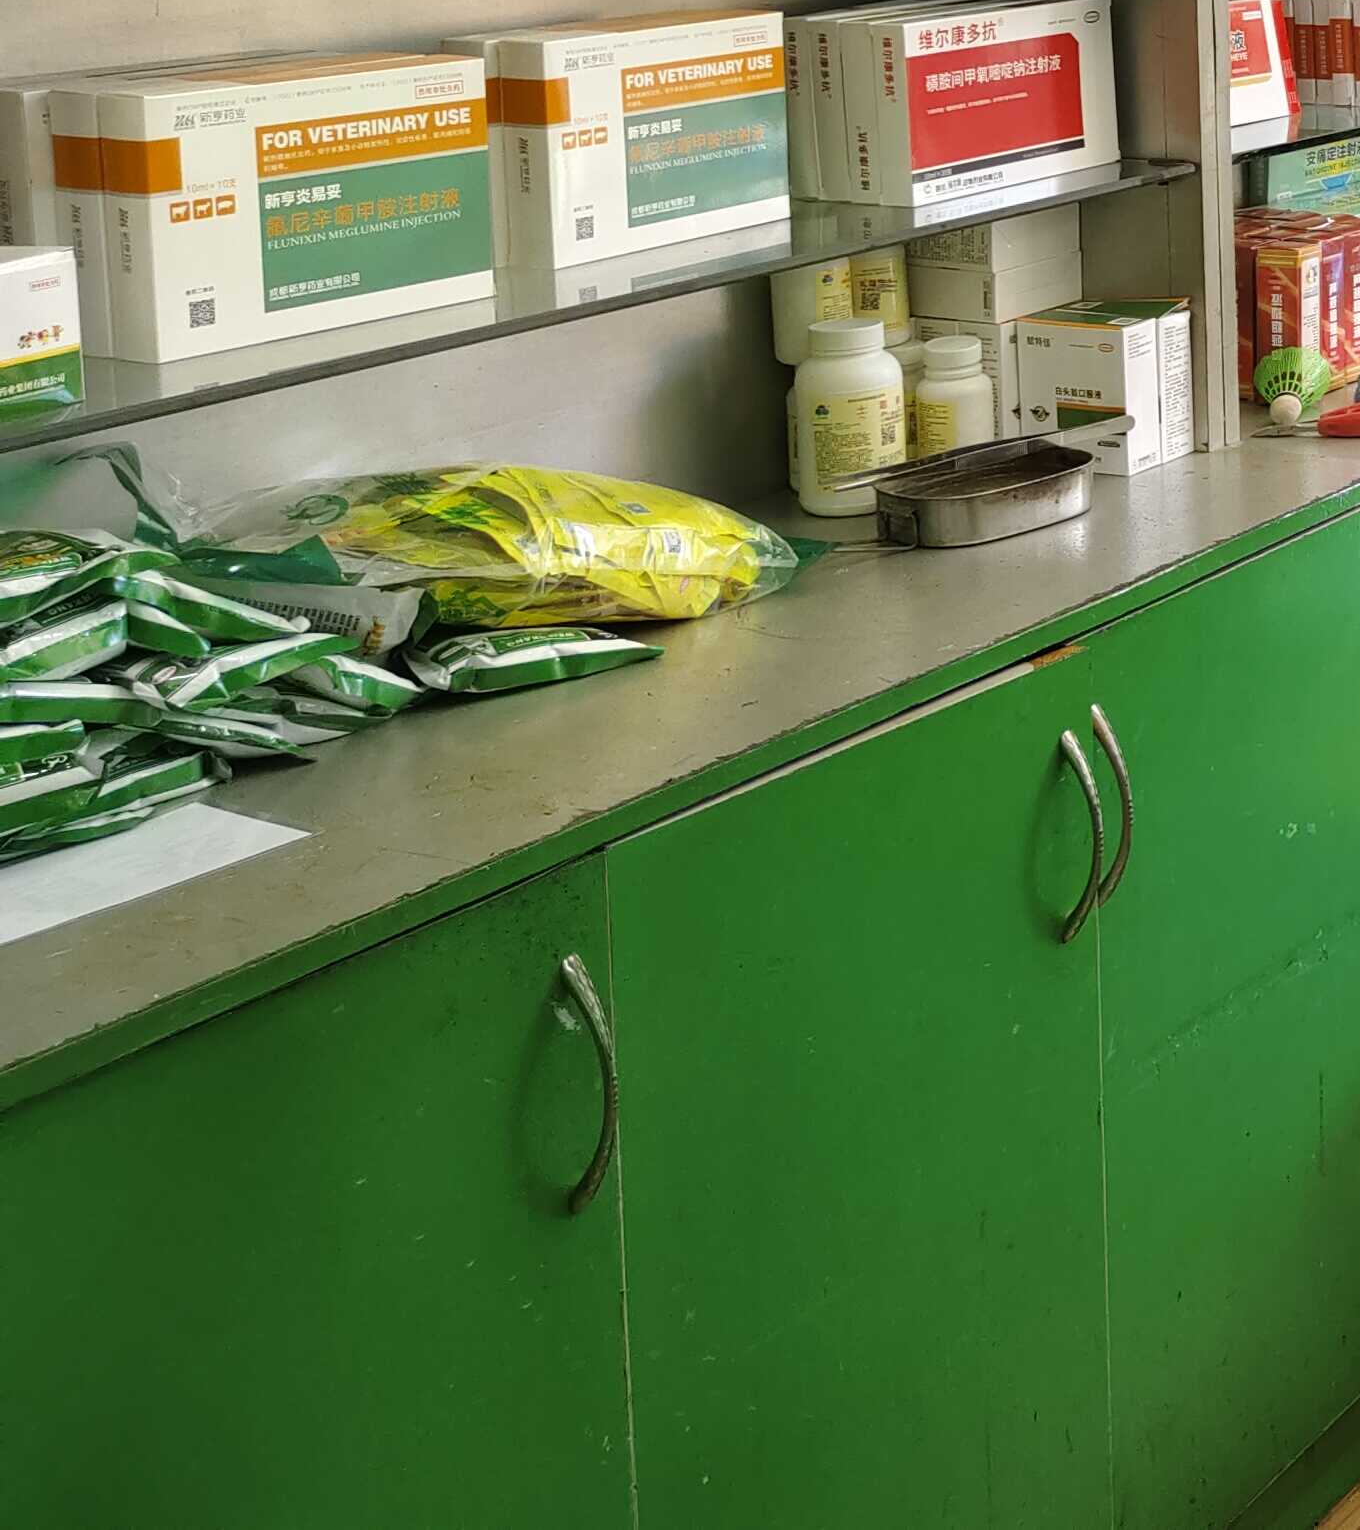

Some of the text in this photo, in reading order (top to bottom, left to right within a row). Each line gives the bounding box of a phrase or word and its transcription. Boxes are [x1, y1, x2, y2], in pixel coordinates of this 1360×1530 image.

[917, 20, 998, 51] 维尔康多抗
[1230, 29, 1247, 52] 液
[625, 54, 774, 90] FOR VETERINARY USE
[924, 54, 1062, 93] 磺胺间甲氧嘧啶钠注射液
[260, 127, 304, 152] FOR
[307, 112, 430, 147] VETERINARY
[432, 106, 473, 128] USE
[629, 142, 768, 175] FLUNIXIN MEGLUMINE INJECTION
[264, 184, 343, 210] 新亨炎易妥
[266, 209, 463, 251] FLUNIXIN MEGLUMINE INJECTION
